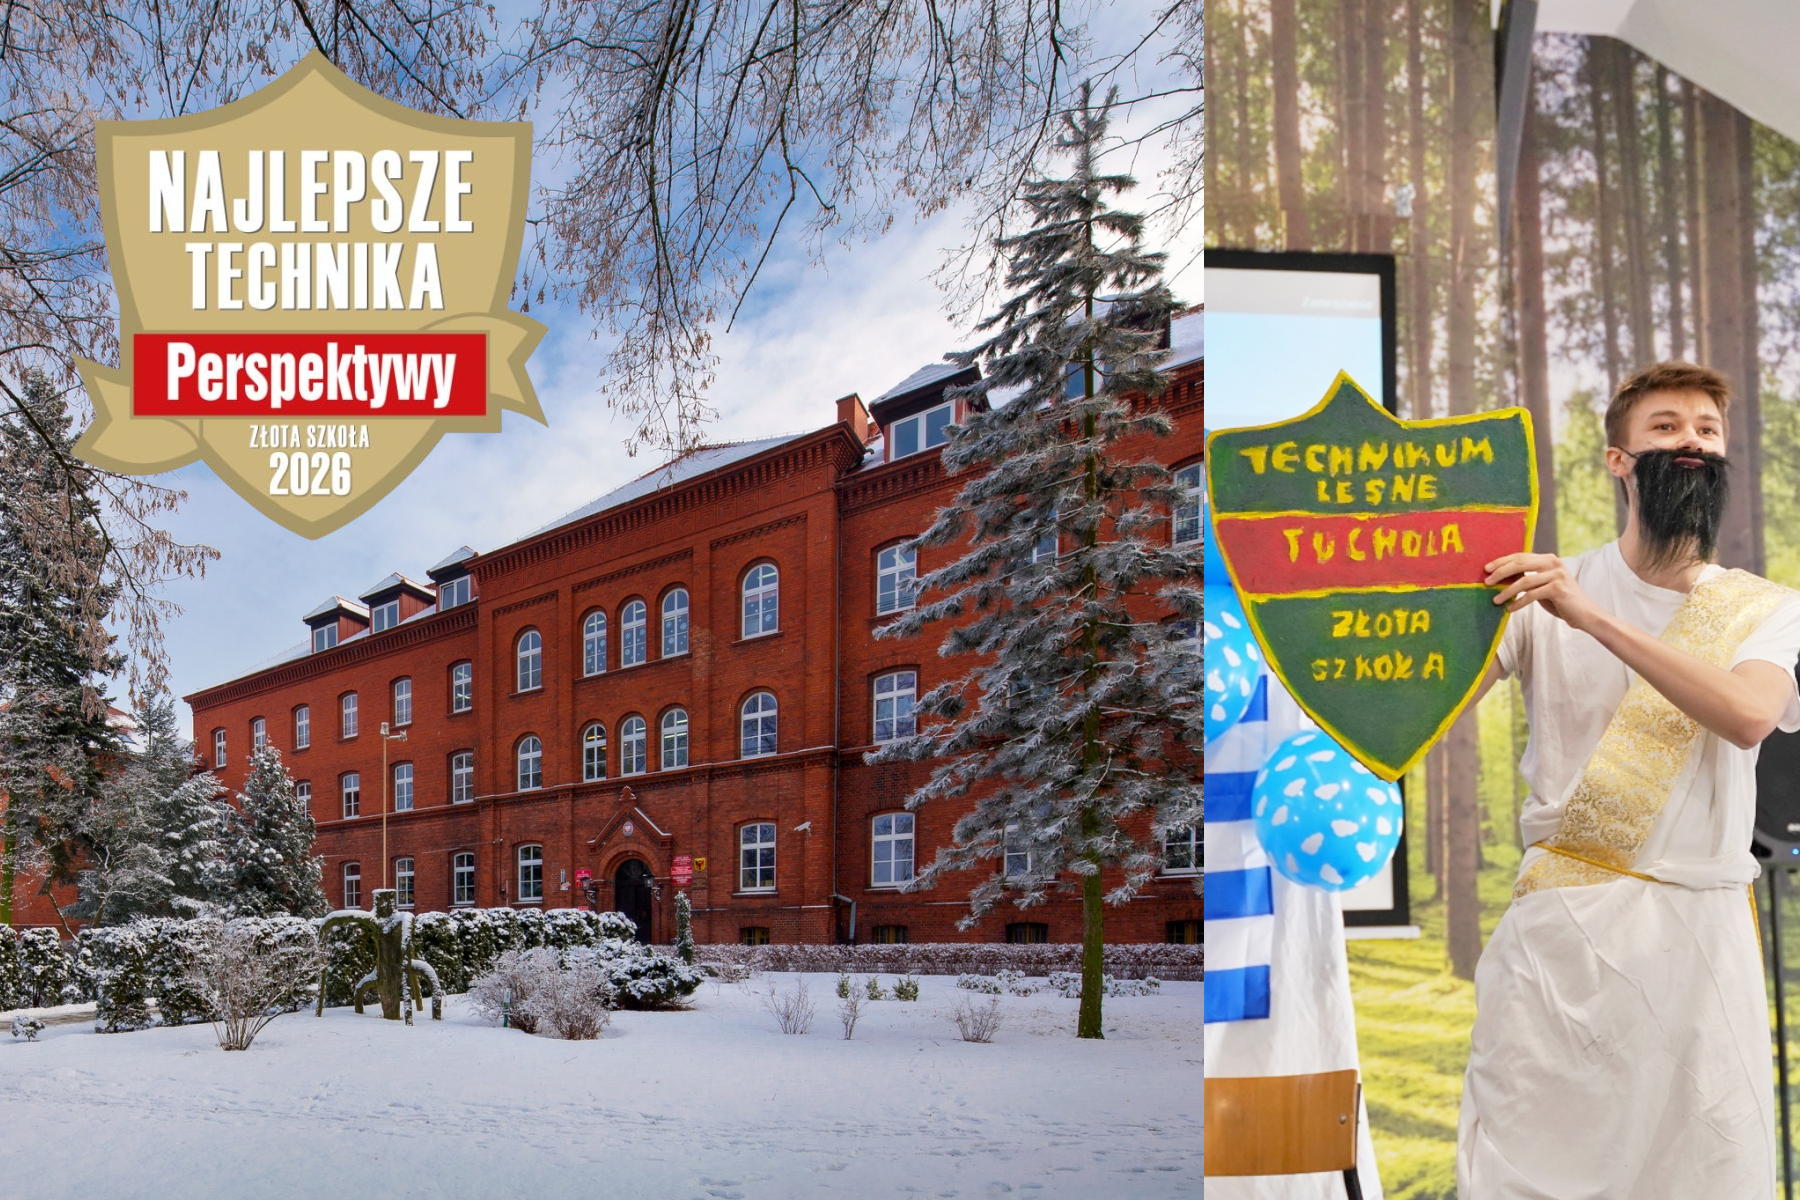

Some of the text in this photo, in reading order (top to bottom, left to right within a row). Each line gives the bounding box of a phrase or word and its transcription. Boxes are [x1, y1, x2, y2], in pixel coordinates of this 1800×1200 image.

[1239, 436, 1493, 477] TECHNIKUM
[1283, 523, 1464, 563] TUCHOLA
[1331, 608, 1431, 639] ZŁOTA
[1311, 650, 1445, 681] SZKOŁA
